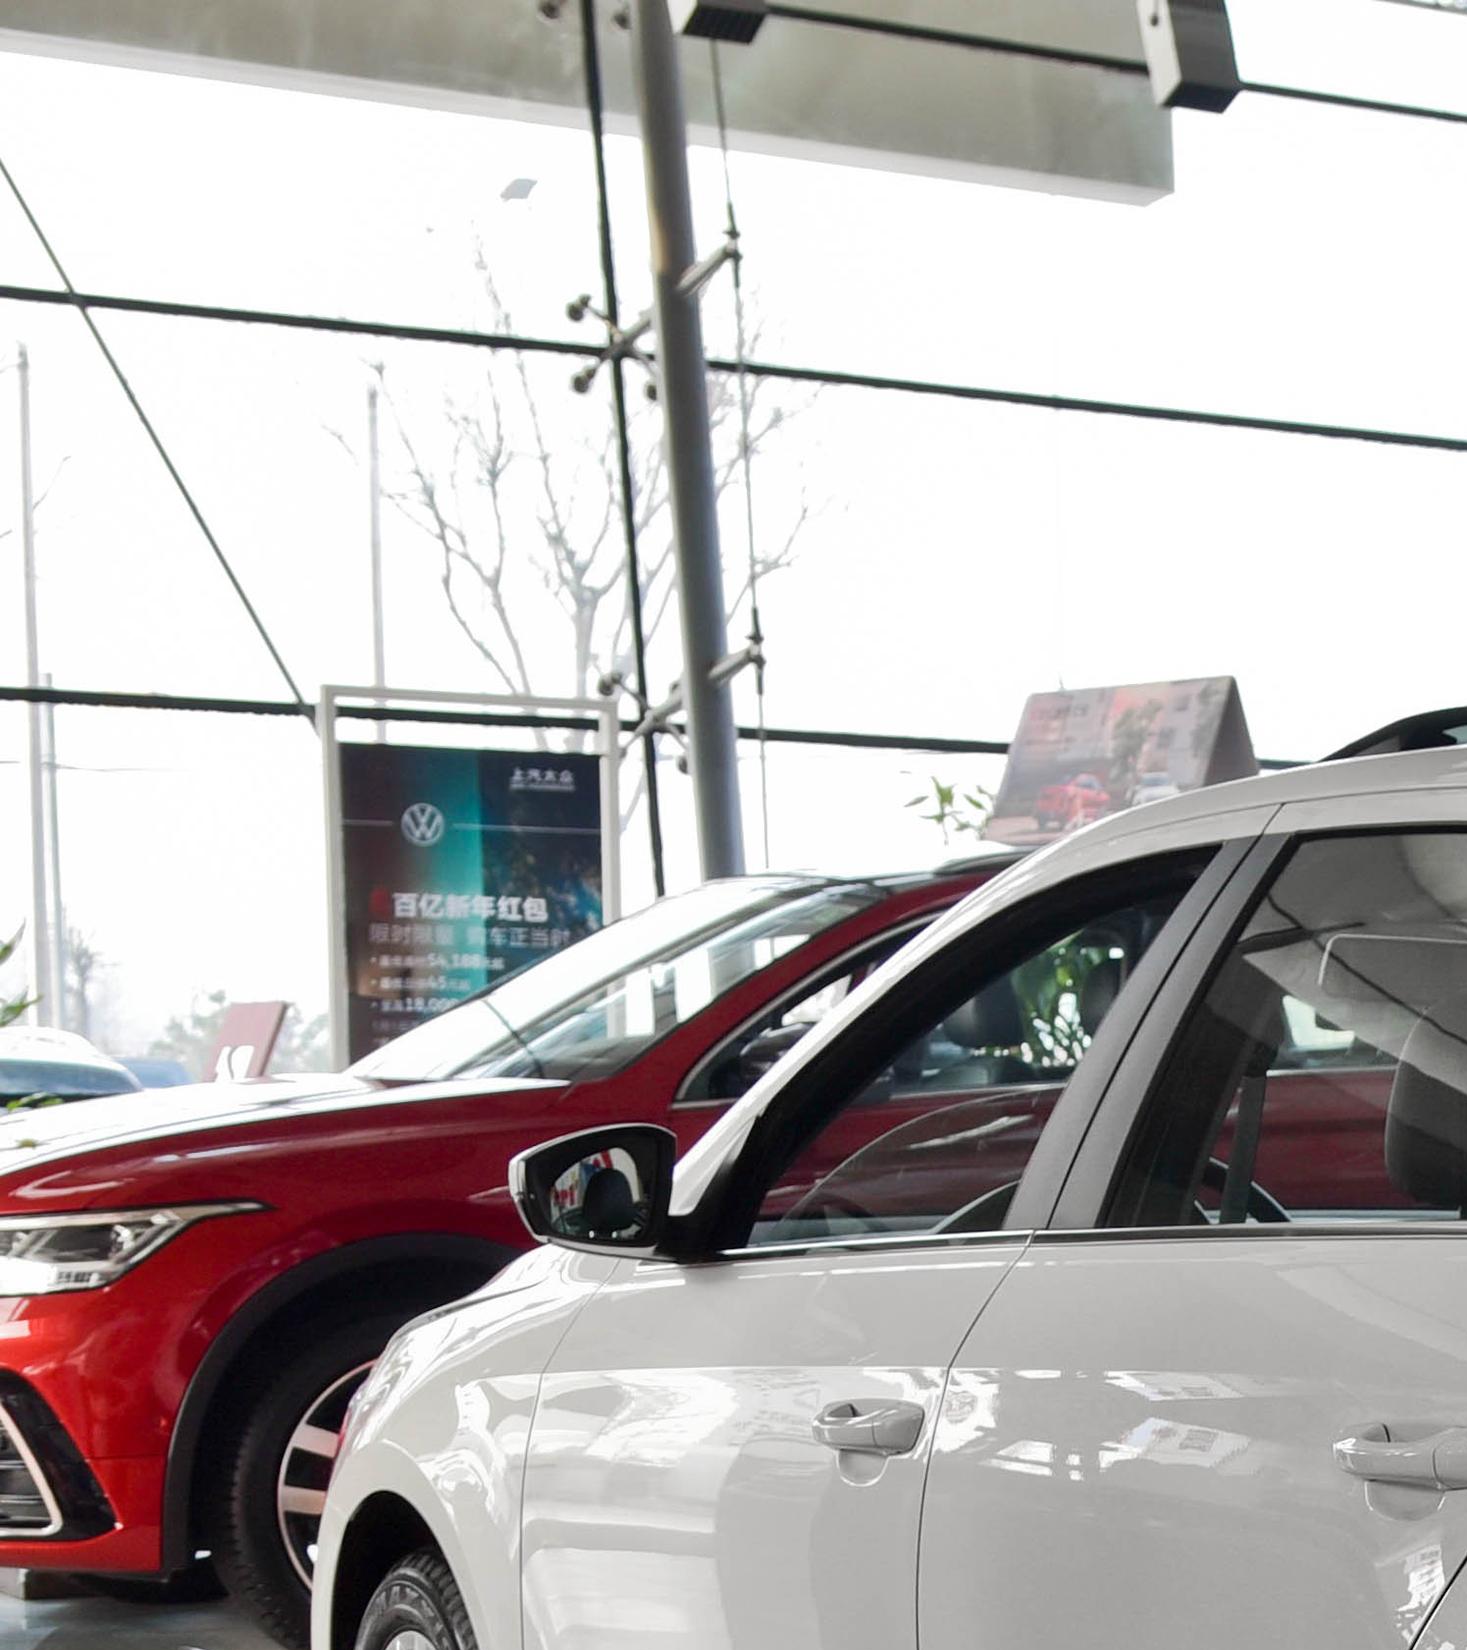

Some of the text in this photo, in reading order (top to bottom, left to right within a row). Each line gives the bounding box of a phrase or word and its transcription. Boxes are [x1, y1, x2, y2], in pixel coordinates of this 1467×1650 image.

[392, 892, 550, 922] 百亿新年红包
